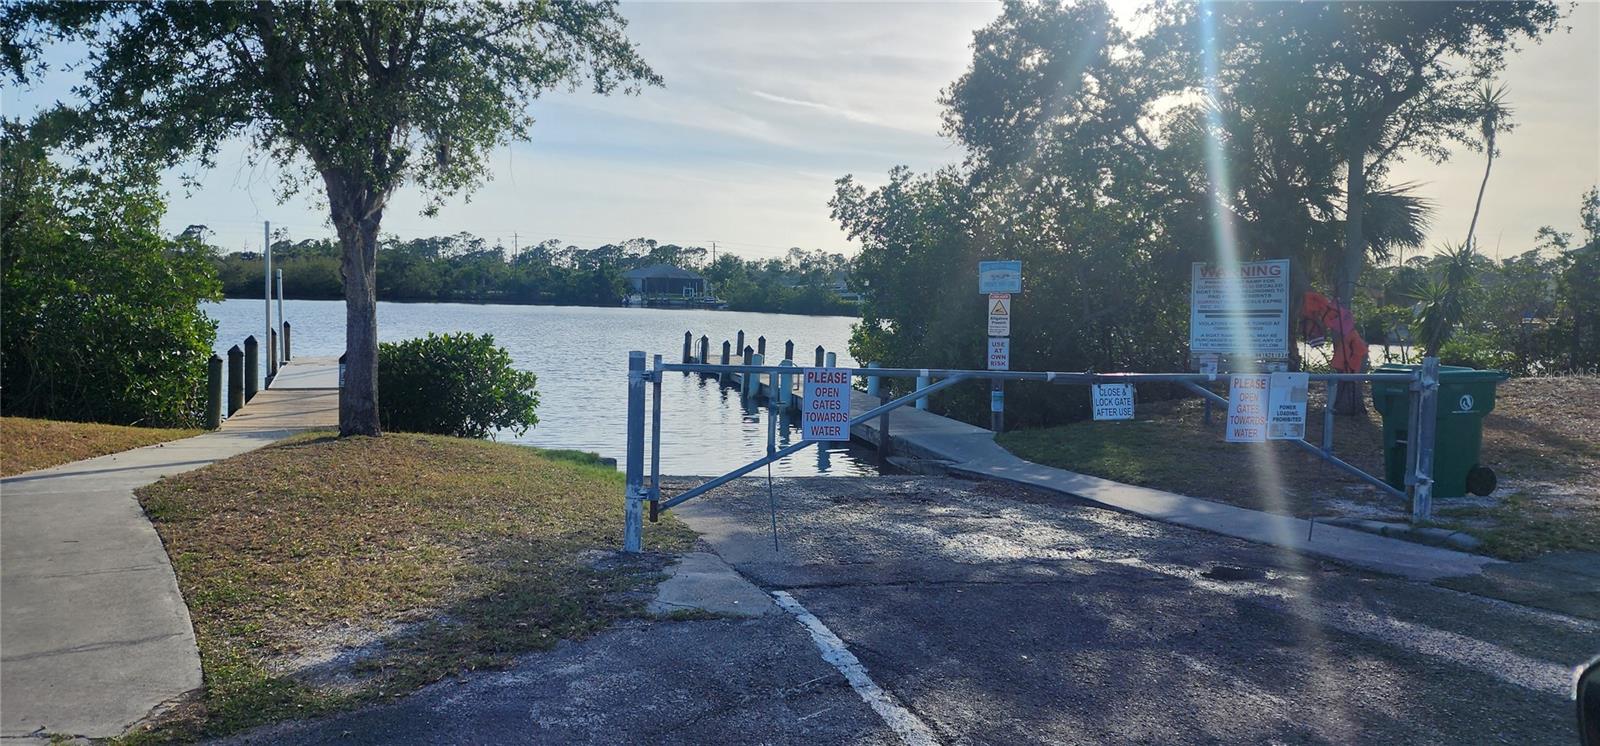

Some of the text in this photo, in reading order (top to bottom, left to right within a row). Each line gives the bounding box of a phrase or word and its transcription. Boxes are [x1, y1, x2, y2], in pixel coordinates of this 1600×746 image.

[808, 372, 848, 384] PLEASE
[1233, 378, 1266, 390] PLEASE
[816, 388, 840, 398] OPEN
[1099, 388, 1126, 396] CLOSE &
[1096, 398, 1132, 406] LOCK GATE
[1240, 393, 1258, 402] OPEN
[812, 400, 840, 410] GATES
[1236, 405, 1259, 414] GATES
[1096, 408, 1132, 416] AFTER USE
[805, 412, 848, 422] TOWARDS
[1230, 416, 1266, 425] TOWARDS
[811, 426, 841, 436] WATER
[1233, 429, 1258, 438] WATER
